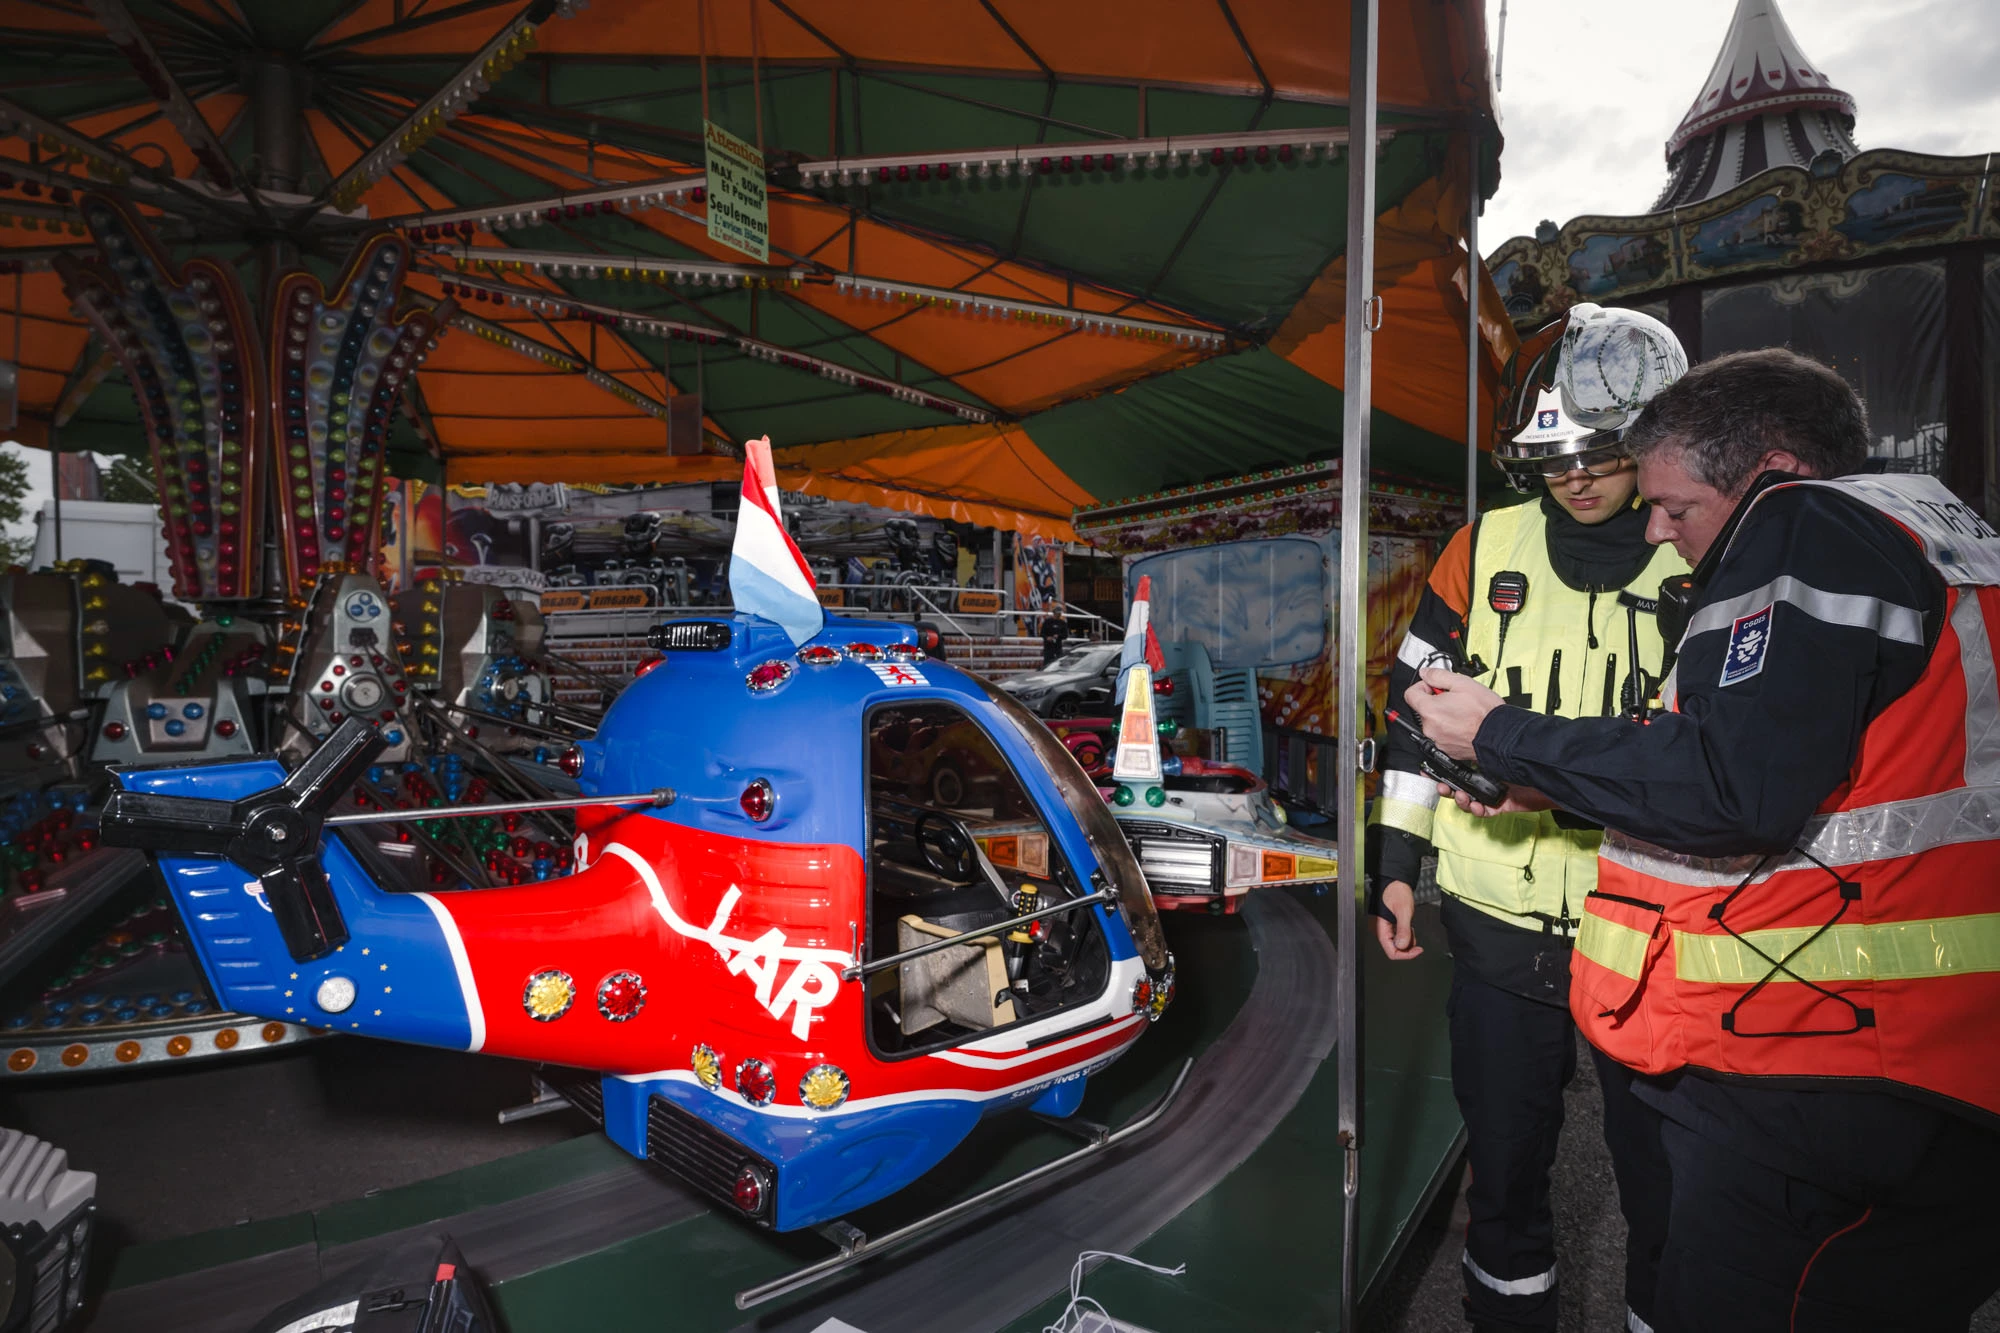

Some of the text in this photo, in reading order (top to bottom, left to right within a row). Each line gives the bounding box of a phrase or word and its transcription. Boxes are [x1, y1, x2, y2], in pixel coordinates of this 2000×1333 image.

[706, 125, 764, 169] Attention
[711, 160, 732, 182] MAX
[732, 185, 762, 210] Payant
[710, 193, 768, 235] Seulement
[594, 594, 642, 606] EINGANG
[962, 598, 997, 607] EINGANG
[1743, 614, 1767, 629] CGDIS
[706, 883, 839, 1042] LAR
[1010, 1080, 1052, 1099] Saving
[1053, 1071, 1080, 1085] lives
